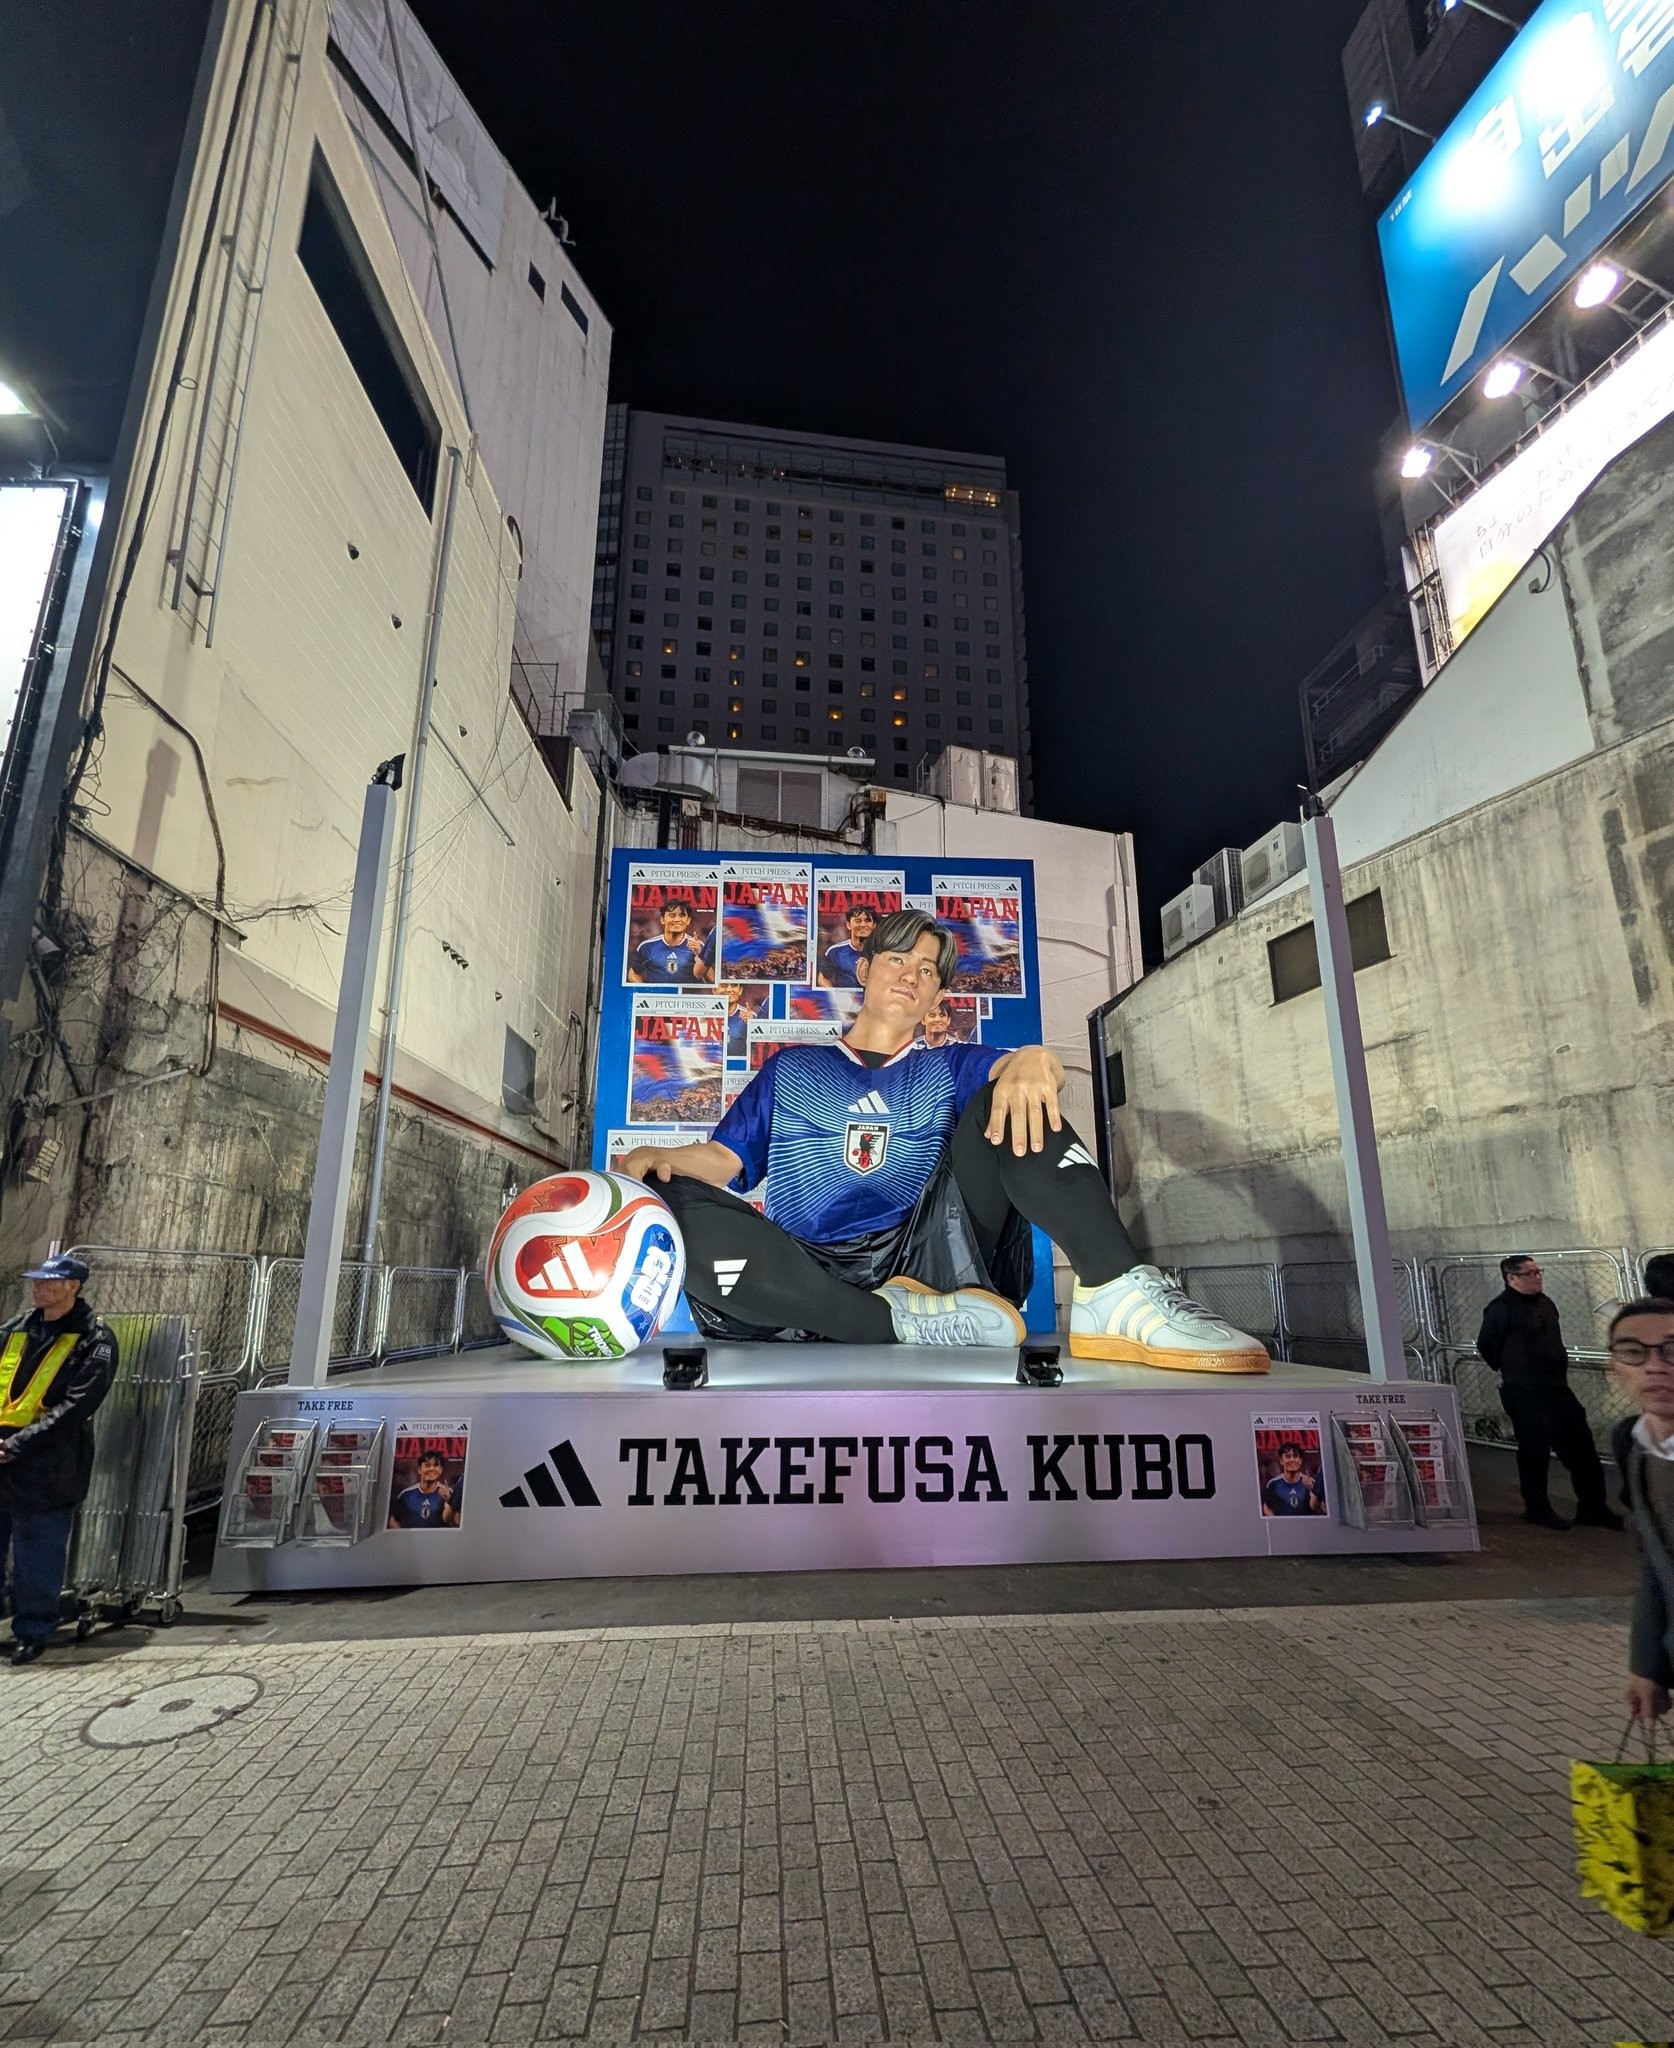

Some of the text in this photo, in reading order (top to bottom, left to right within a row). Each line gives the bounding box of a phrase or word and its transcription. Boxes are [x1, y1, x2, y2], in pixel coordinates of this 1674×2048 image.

[651, 870, 701, 878] PITCH PRESS
[742, 867, 791, 876] PITCH PRESS
[835, 875, 884, 884] PITCH PRESS
[953, 882, 1001, 890] PITCH PRESS
[632, 884, 718, 909] JAPAN
[723, 882, 808, 905] JAPAN
[818, 890, 901, 914] JAPAN
[936, 896, 1019, 921] JAPAN
[655, 1000, 706, 1009] PITCH PRESS
[635, 1016, 725, 1041] JAPAN
[769, 1026, 821, 1035] PITCH PRESS
[631, 1137, 684, 1147] PITCH PRESS
[1356, 1394, 1406, 1404] TAKE FREE
[297, 1401, 354, 1411] TAKE FREE
[1256, 1430, 1319, 1450] JAPAN
[396, 1437, 468, 1458] JAPAN
[619, 1433, 1217, 1507] TAKEFUSA KUBO
